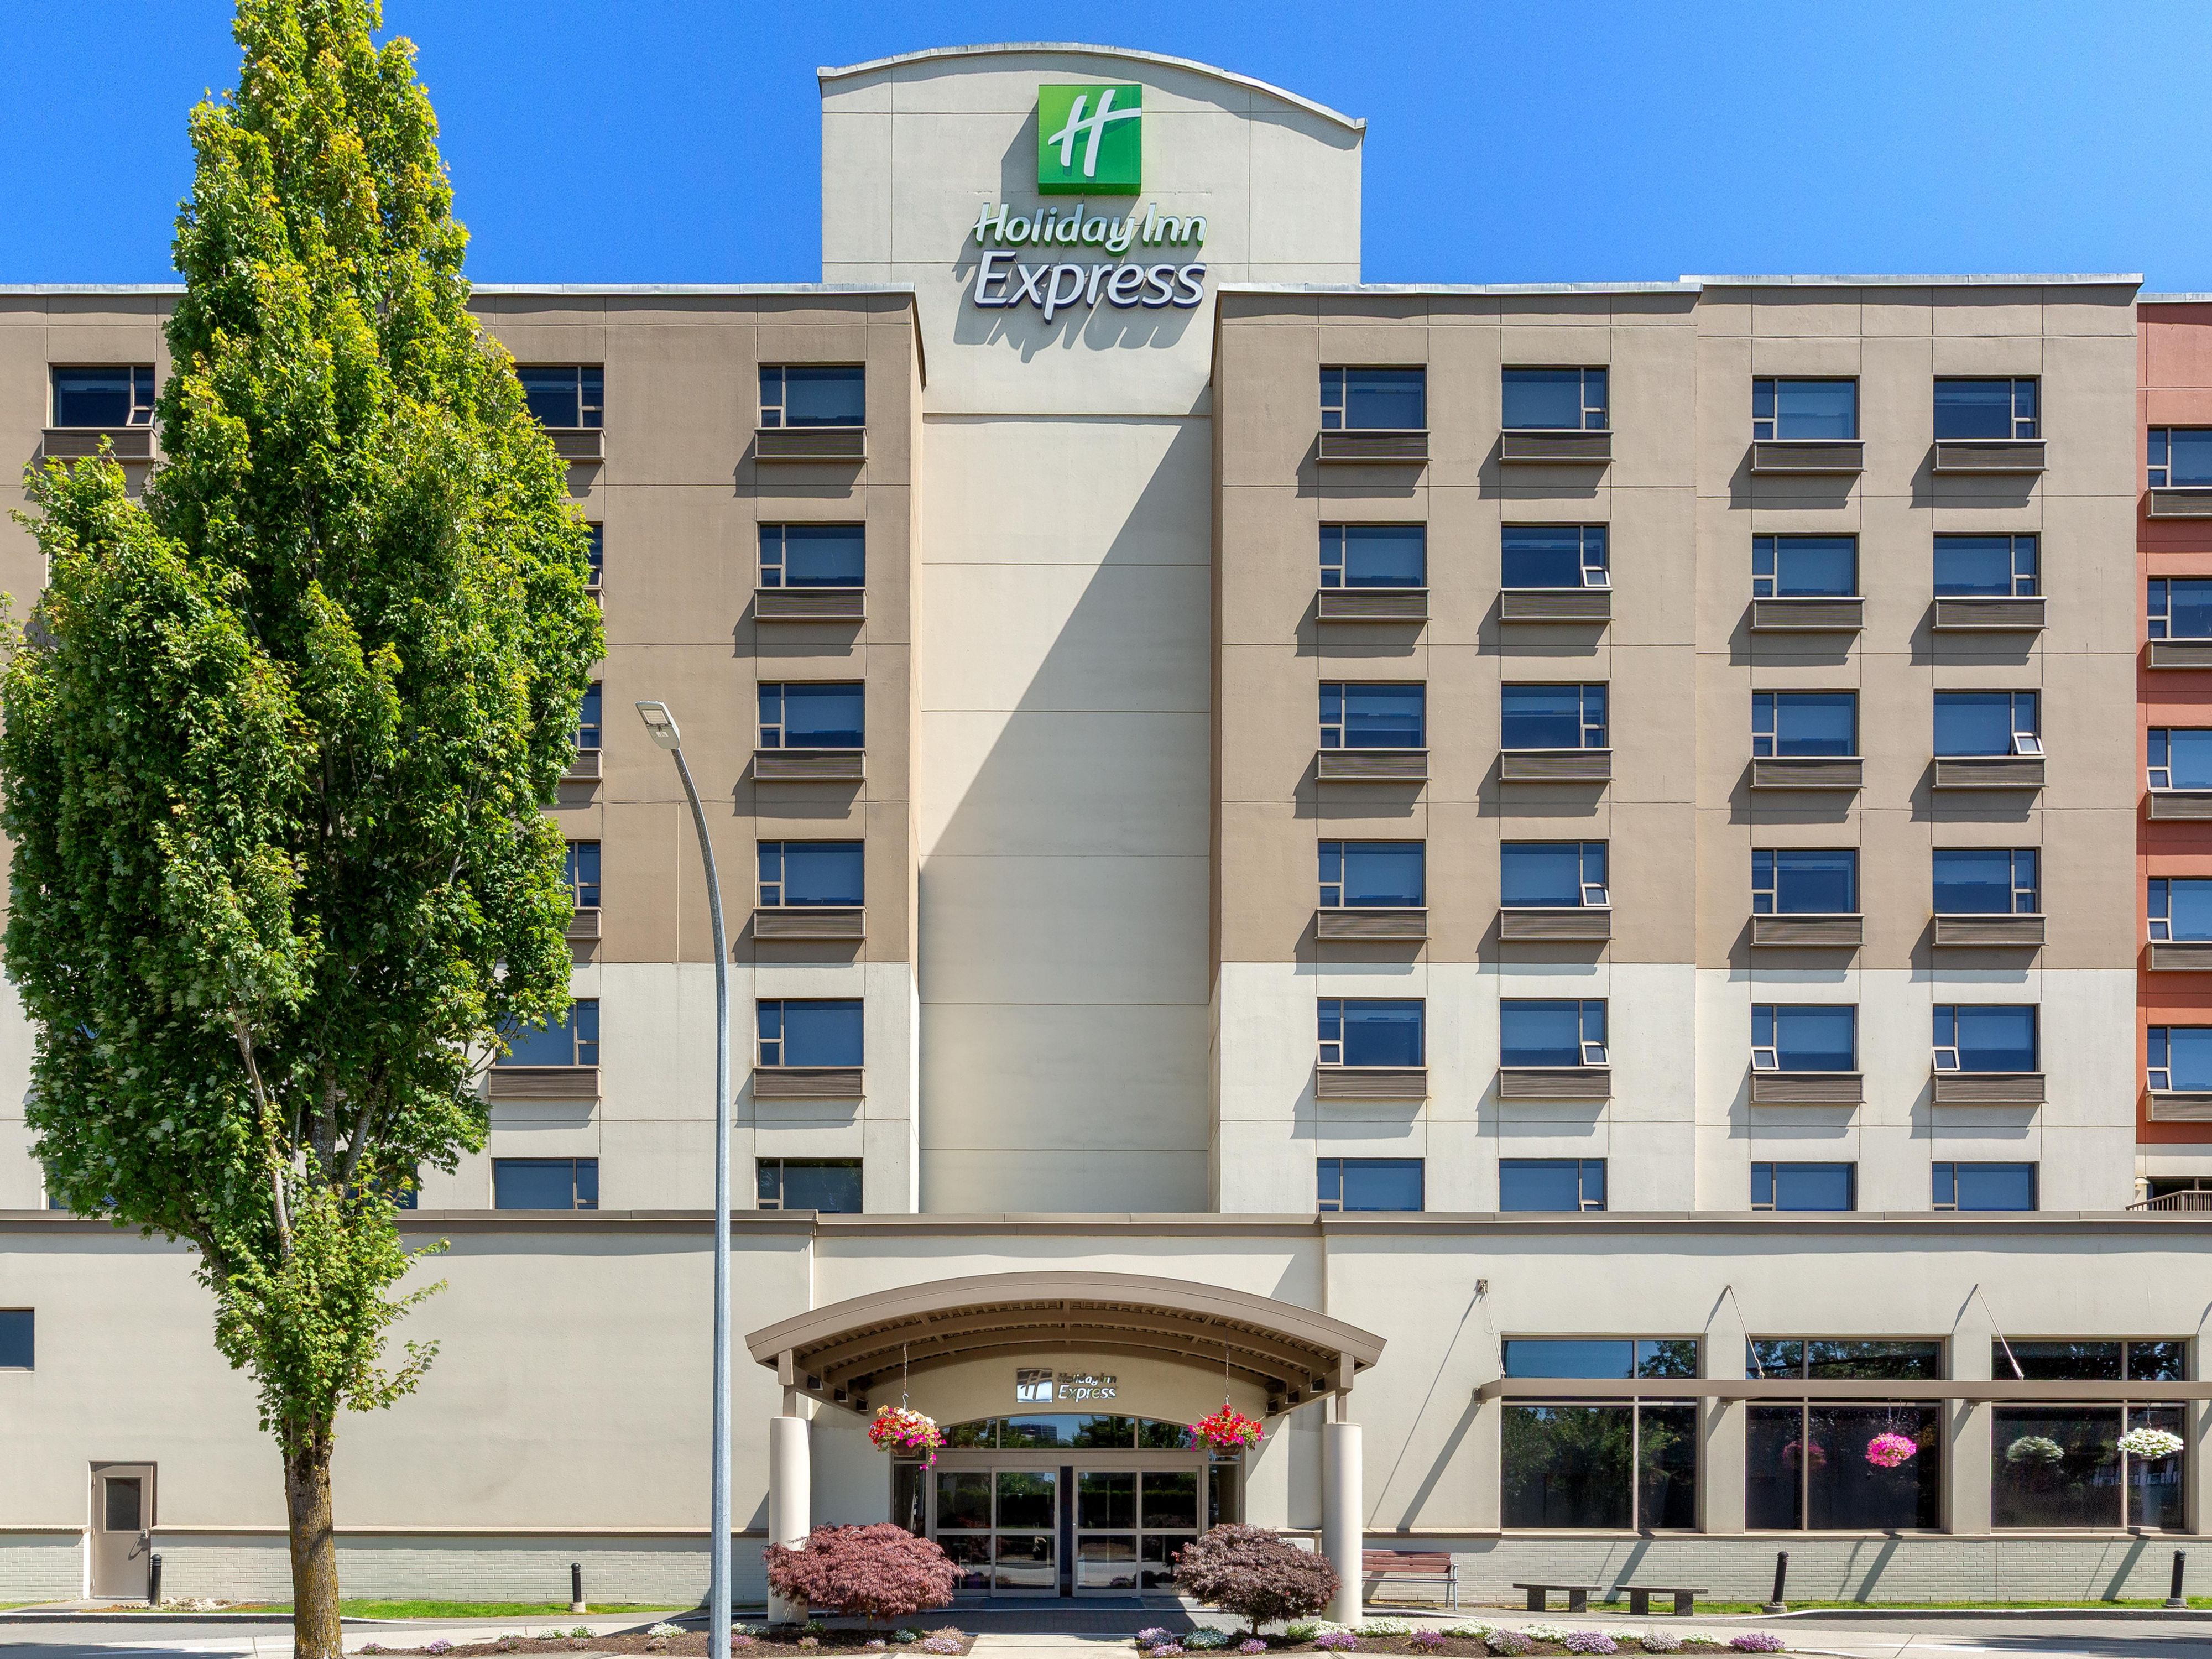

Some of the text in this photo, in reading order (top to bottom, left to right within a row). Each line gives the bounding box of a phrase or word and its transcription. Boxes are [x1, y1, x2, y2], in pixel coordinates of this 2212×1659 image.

[1048, 89, 1141, 177] H
[973, 202, 1207, 256] Holiday Inn
[974, 250, 1206, 325] Express
[1057, 1373, 1117, 1386] Holiday Inn
[1057, 1384, 1117, 1402] Express
